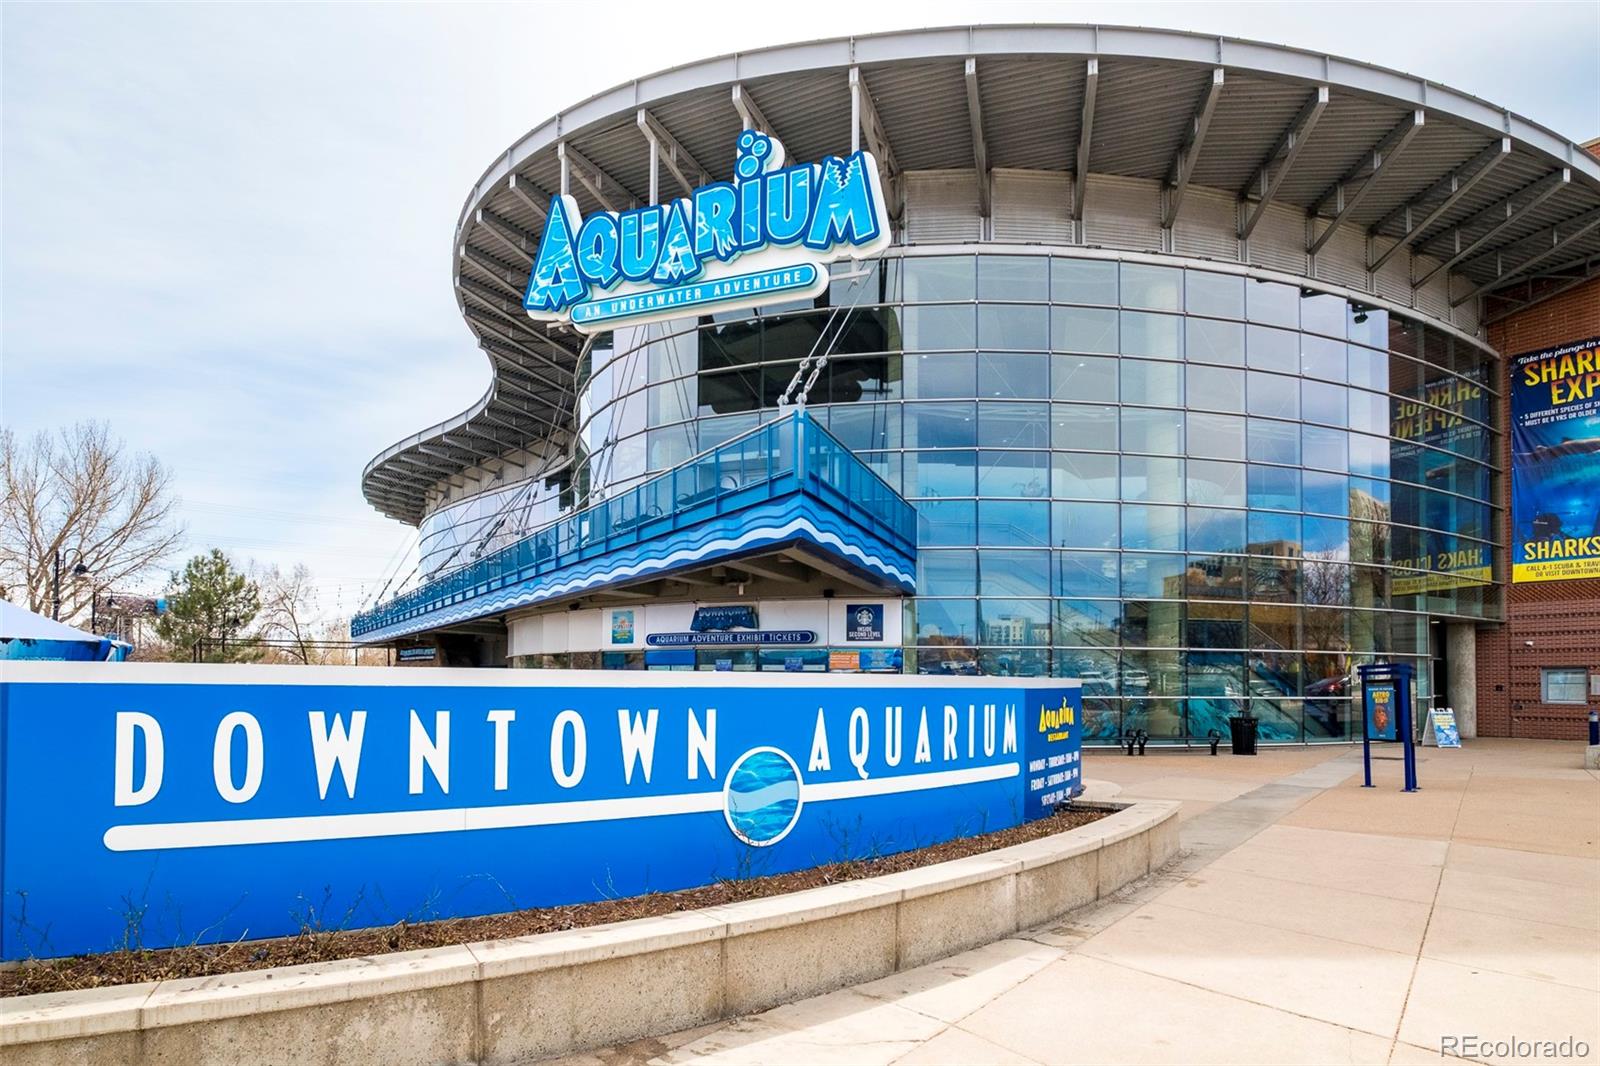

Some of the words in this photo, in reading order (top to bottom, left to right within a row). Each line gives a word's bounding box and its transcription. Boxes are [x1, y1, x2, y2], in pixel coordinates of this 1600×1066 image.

[525, 131, 878, 310] AQUARIUM
[584, 306, 601, 318] AN
[611, 288, 702, 313] UNDERWATER
[713, 271, 801, 296] ADVENTURE
[1518, 355, 1539, 364] Take
[1540, 352, 1553, 360] the
[1554, 344, 1585, 358] plunge
[1525, 418, 1541, 426] MUST
[1542, 416, 1550, 424] BE
[1556, 413, 1567, 421] YRS
[1568, 411, 1577, 419] OR
[1578, 408, 1597, 417] OLDER
[1529, 408, 1560, 419] DIFFERENT
[1560, 403, 1584, 413] SPECIES
[1584, 401, 1593, 409] OF
[1524, 535, 1600, 560] SHARKS
[1554, 562, 1574, 570] SCUBA
[656, 635, 689, 644] AQUARIUM
[692, 634, 733, 643] ADVENTURE
[736, 633, 765, 642] EXHIBIT
[769, 633, 801, 641] TICKETS
[113, 708, 717, 808] DOWNTOWN
[808, 704, 1019, 780] AQUARIUM
